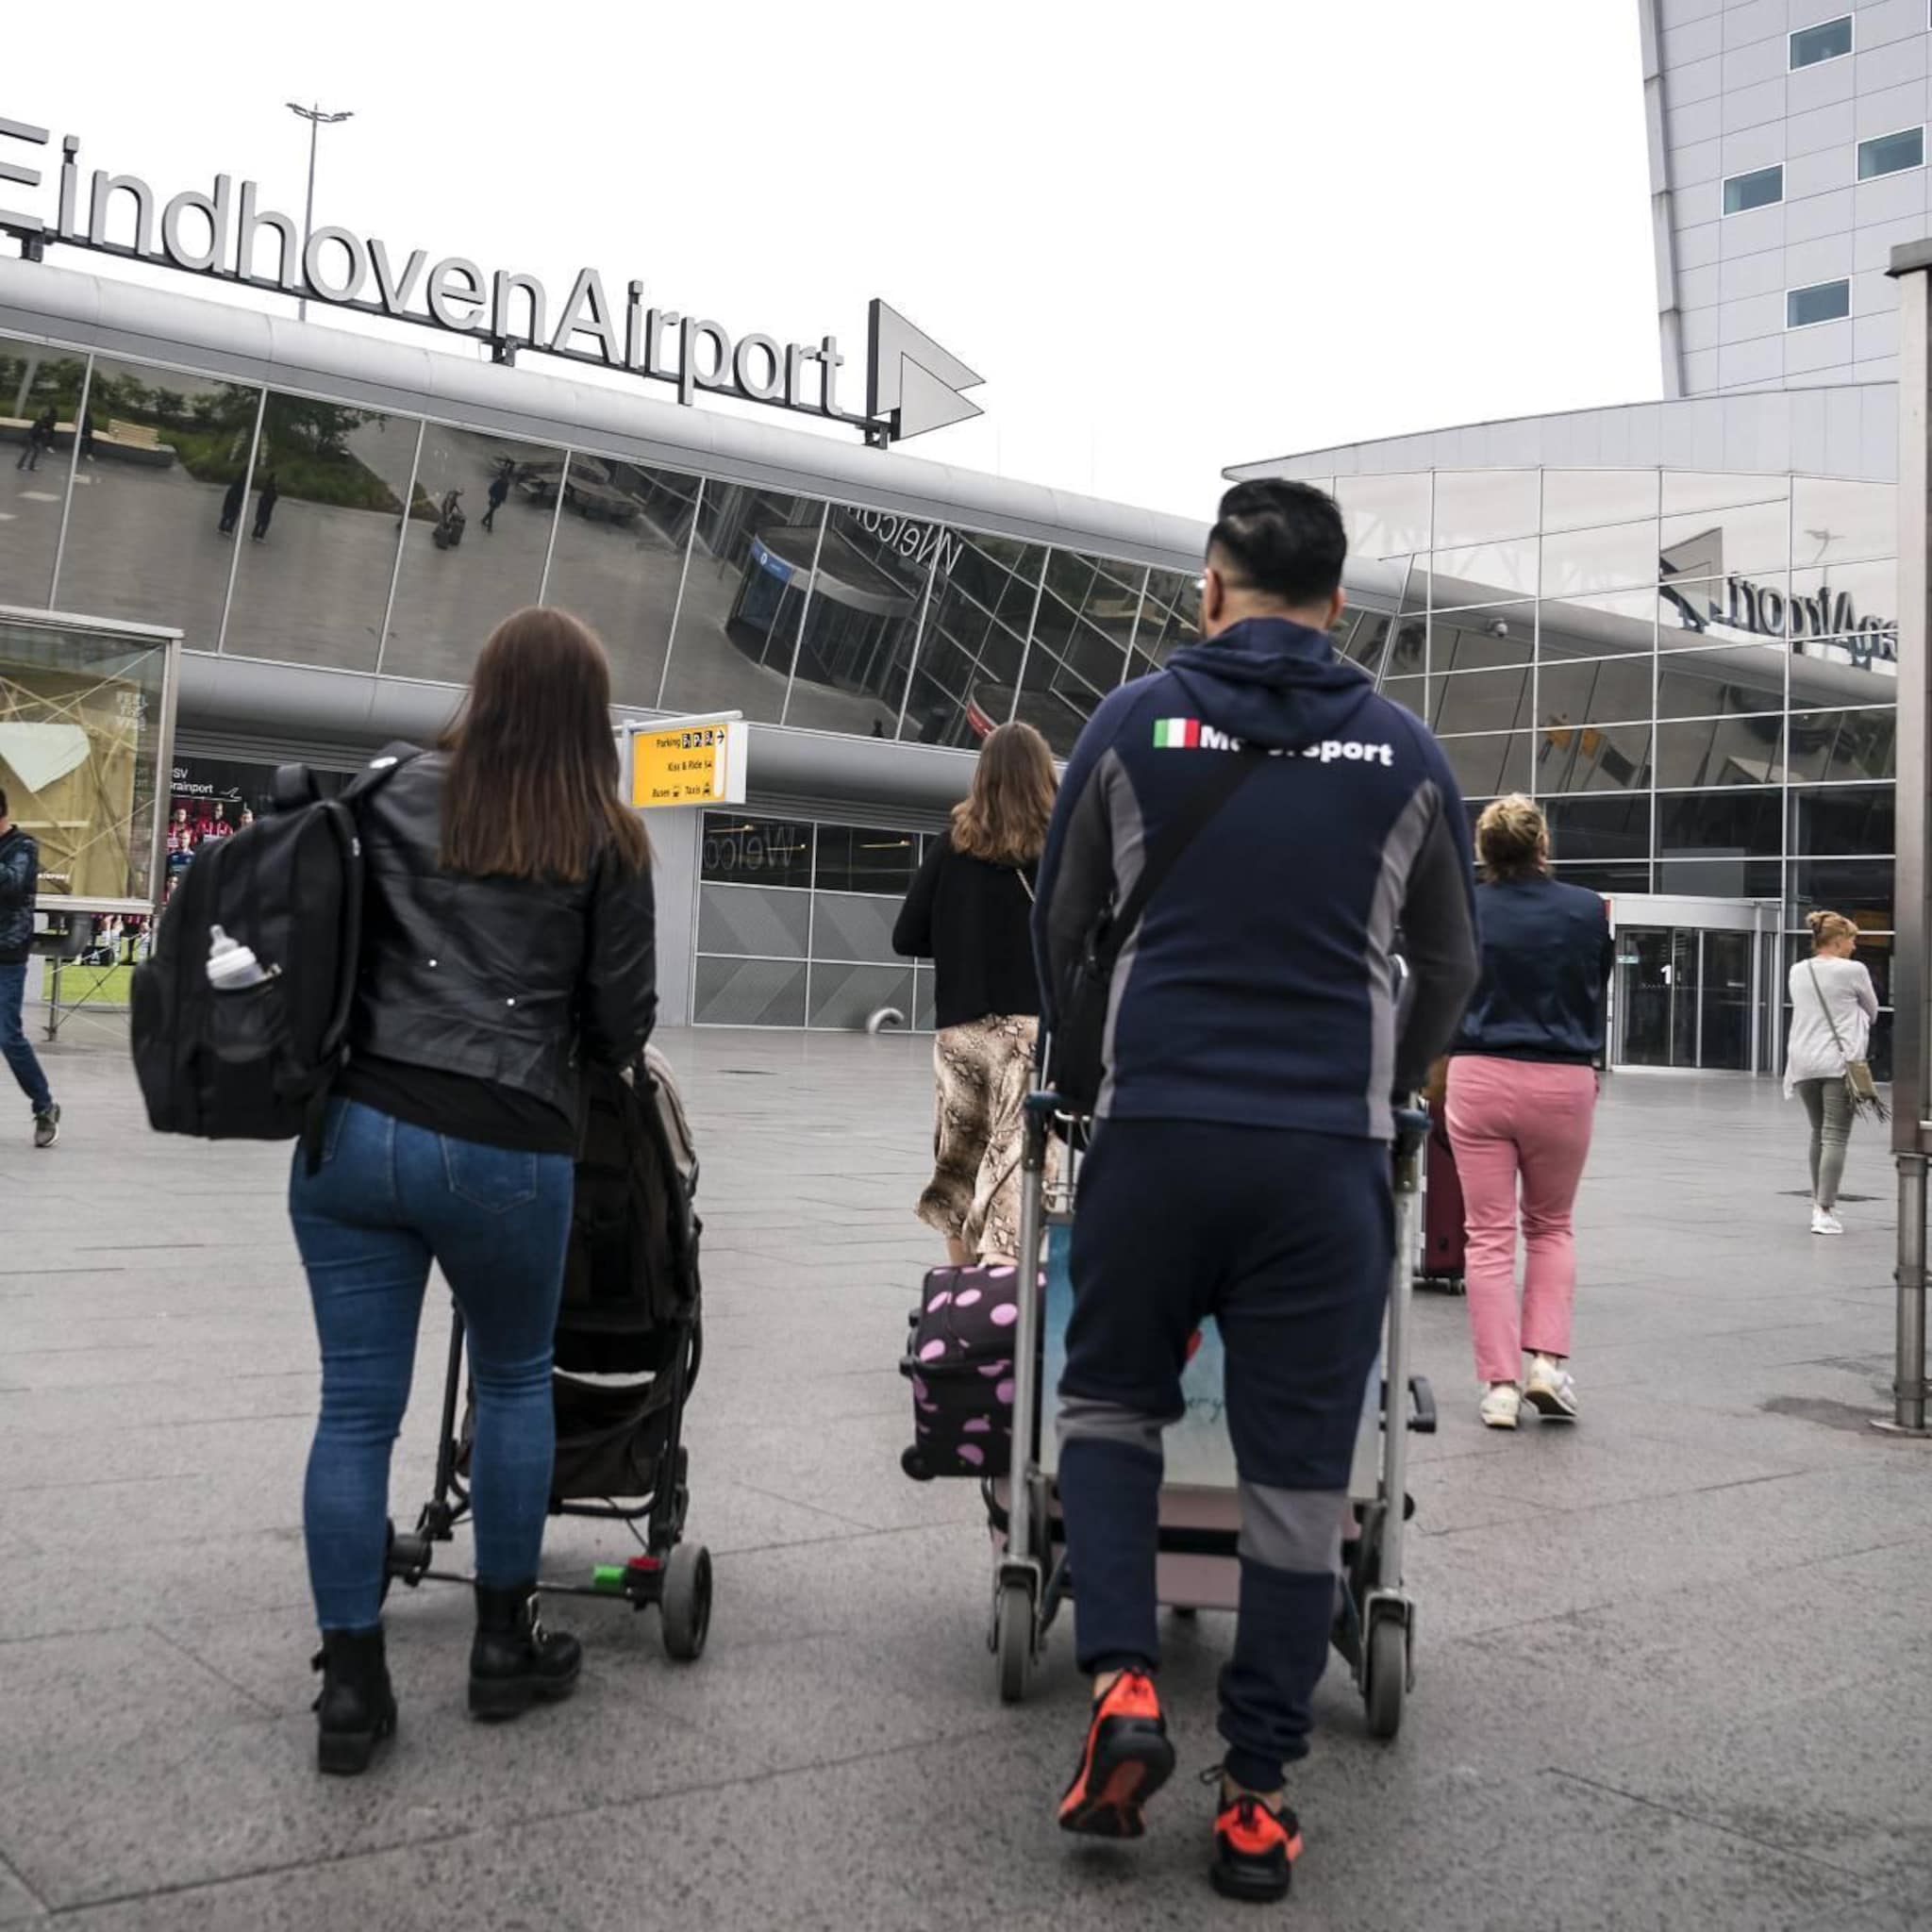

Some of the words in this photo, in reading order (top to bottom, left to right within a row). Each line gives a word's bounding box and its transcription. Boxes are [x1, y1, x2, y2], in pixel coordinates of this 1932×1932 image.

[657, 738, 680, 749] Parking
[688, 760, 702, 770] Ride
[173, 767, 189, 779] SV
